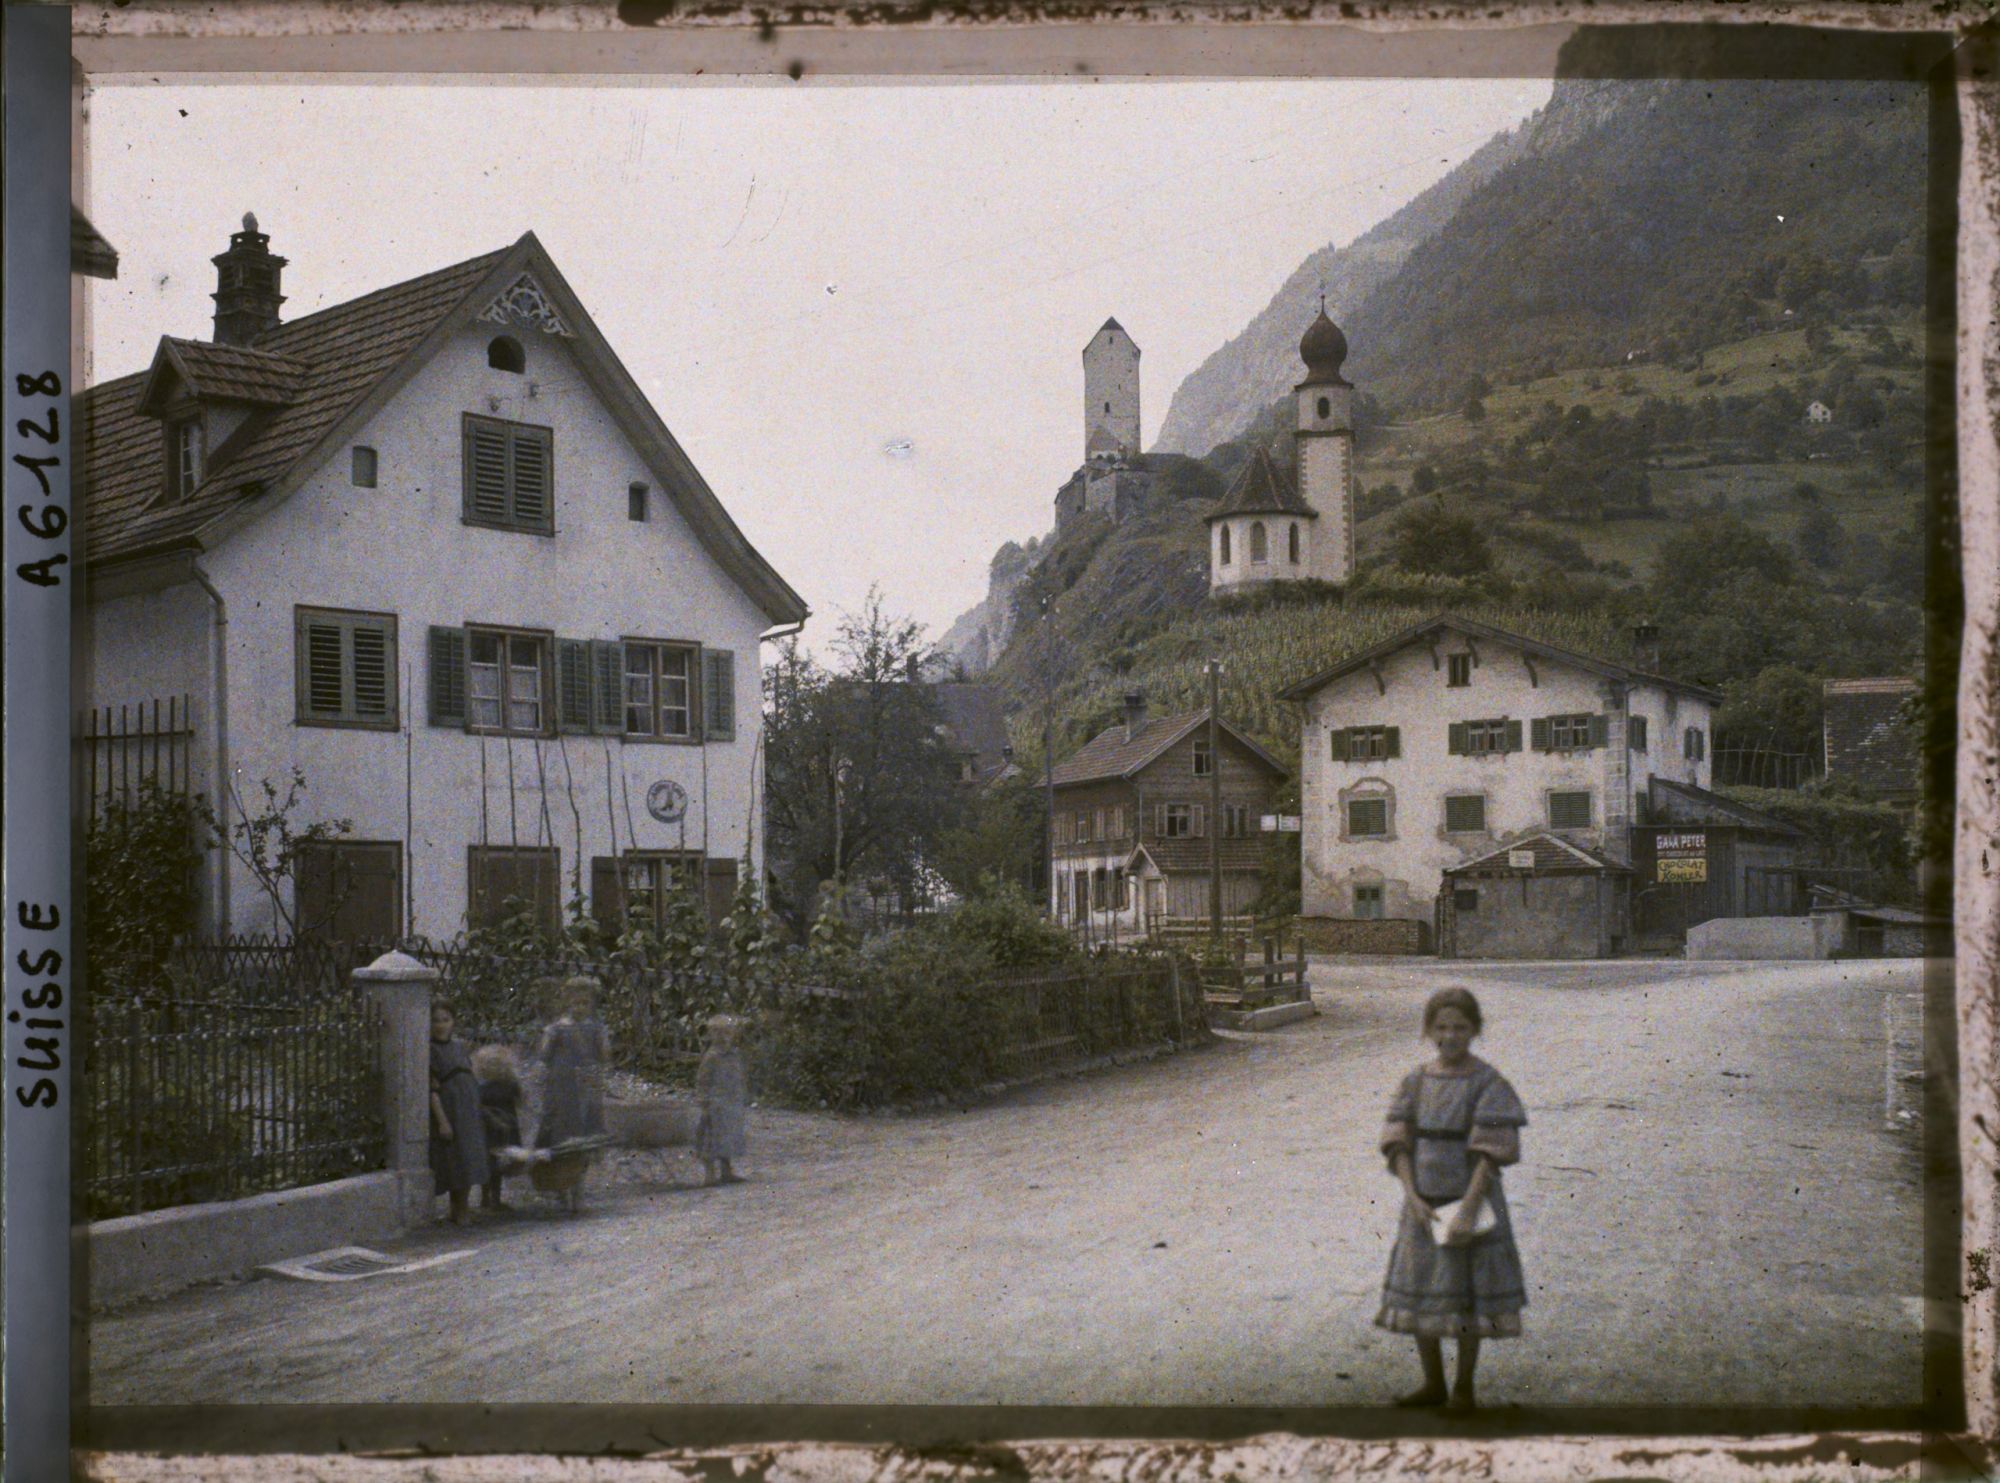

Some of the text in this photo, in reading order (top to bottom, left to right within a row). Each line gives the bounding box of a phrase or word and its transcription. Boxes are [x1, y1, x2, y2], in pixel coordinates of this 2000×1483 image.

[1681, 833, 1706, 849] PETER
[1659, 859, 1704, 871] CHOCOLAT
[1662, 870, 1703, 881] KOHLER
